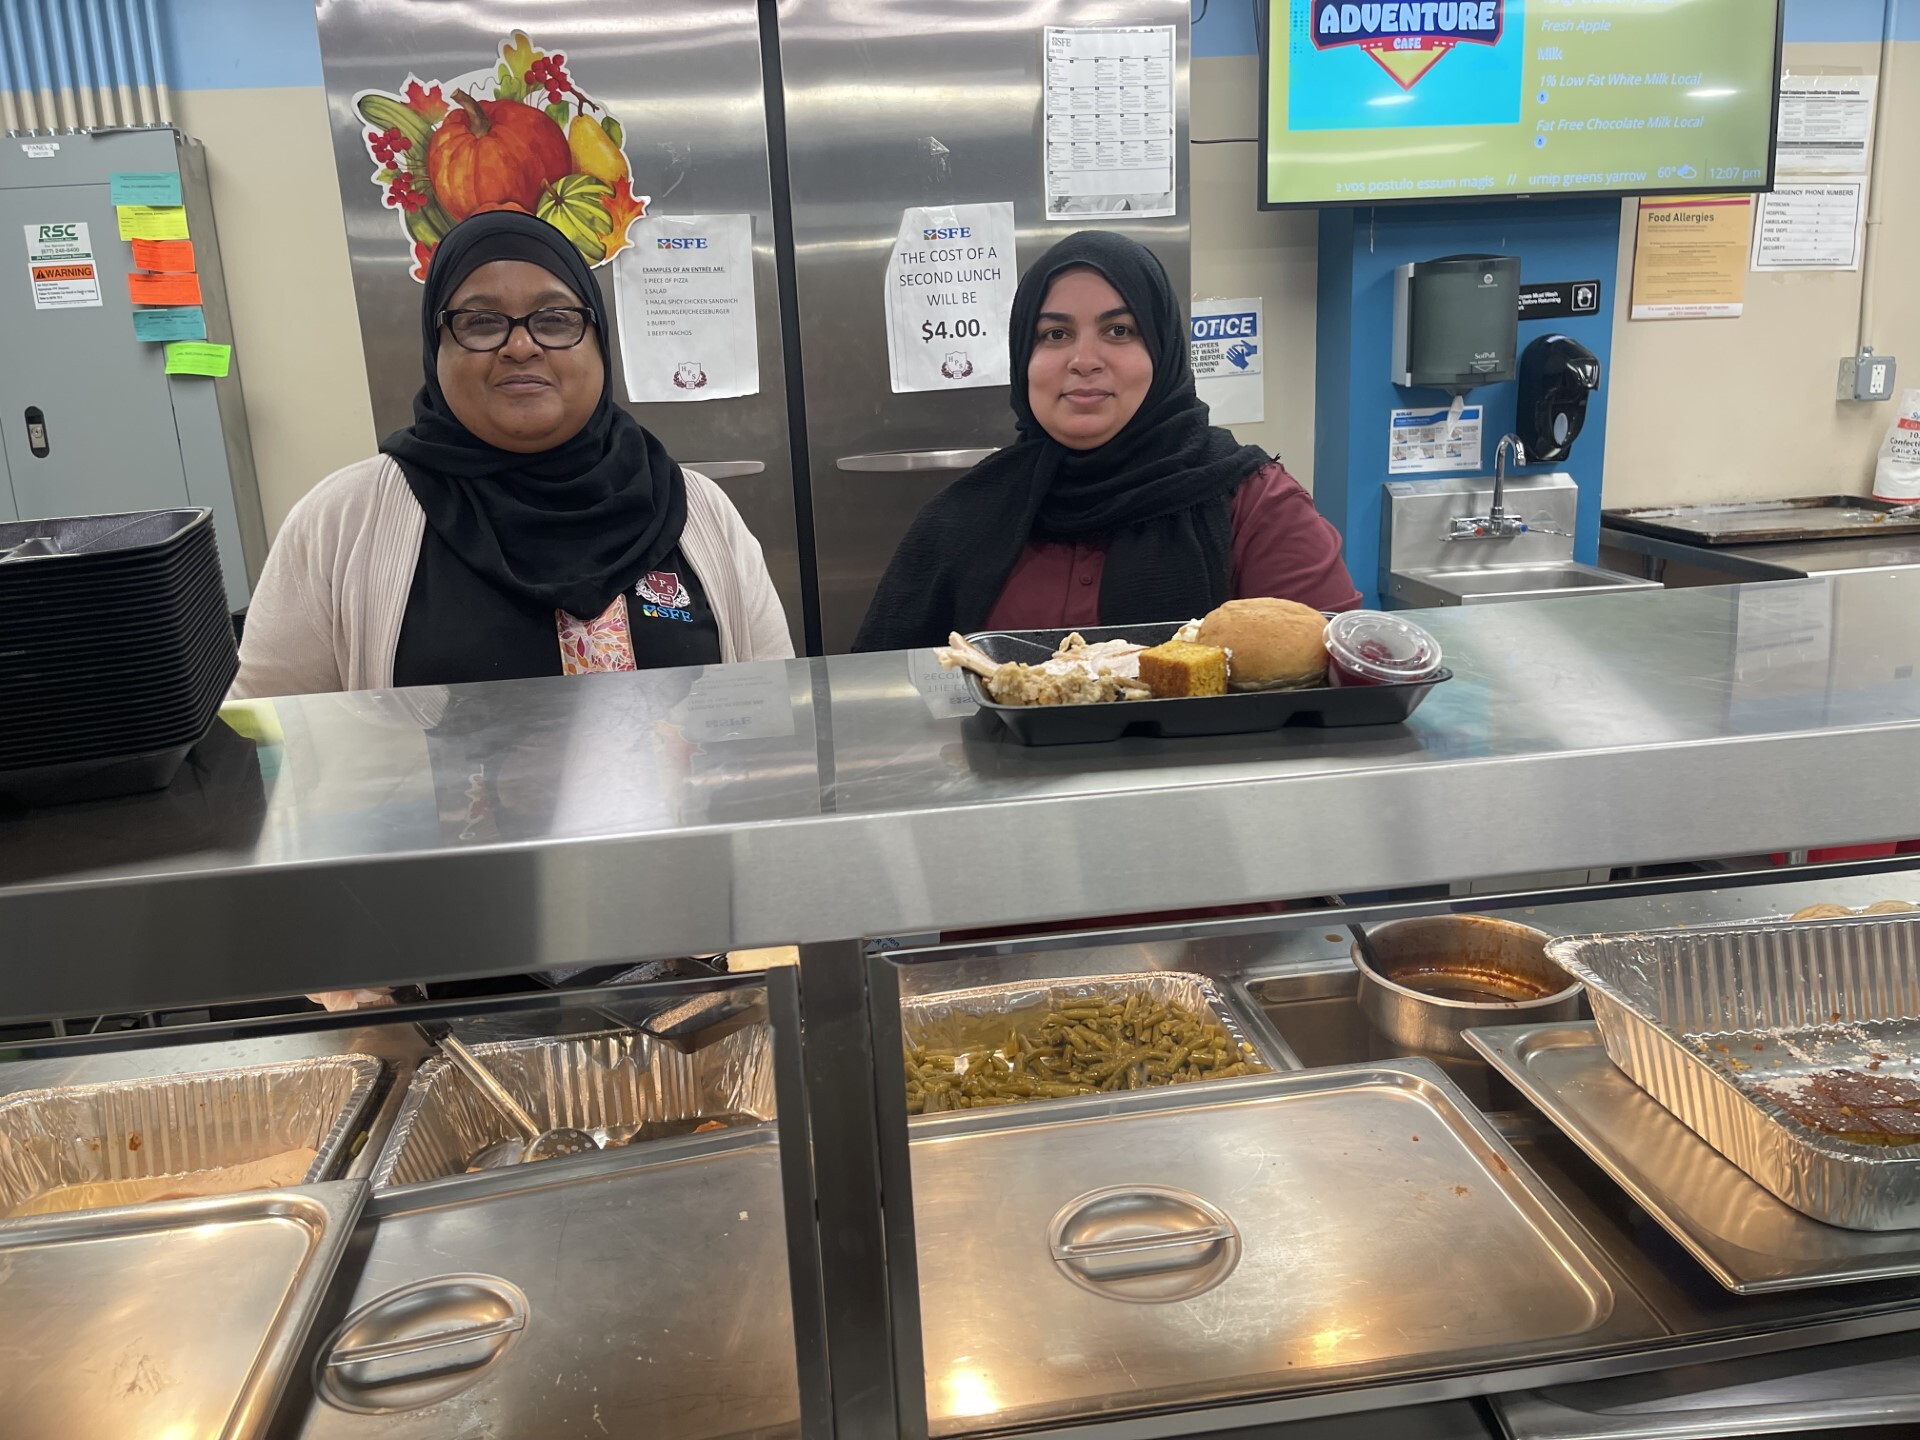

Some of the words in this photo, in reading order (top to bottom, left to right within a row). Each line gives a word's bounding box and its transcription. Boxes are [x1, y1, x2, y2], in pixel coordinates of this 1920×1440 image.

[1319, 2, 1497, 34] ADVENTURE
[1541, 19, 1573, 32] Fresh
[1576, 19, 1611, 34] Apple
[1393, 37, 1421, 50] CAFE
[1537, 47, 1562, 60] Milk
[1540, 75, 1556, 87] 1%
[1559, 74, 1584, 87] Low
[1587, 74, 1605, 86] Fat
[1608, 72, 1641, 86] White
[1645, 72, 1667, 85] Milk
[1671, 72, 1702, 86] Local
[1536, 119, 1554, 131] Fat
[1557, 119, 1584, 131] Free
[1586, 117, 1643, 130] Chocolate
[1647, 116, 1670, 129] Milk
[1673, 116, 1704, 128] Local
[1345, 182, 1365, 192] vos
[1367, 178, 1414, 193] postulo
[1416, 179, 1456, 190] essum
[1459, 175, 1495, 190] magis
[1563, 173, 1603, 187] greens
[1605, 171, 1647, 186] yarrow
[1710, 167, 1739, 180] 12:07
[1742, 168, 1761, 182] pm
[1648, 213, 1671, 222] Food
[1673, 212, 1714, 224] Allergies
[39, 224, 76, 238] RSC
[937, 227, 971, 240] SFE
[672, 238, 708, 249] SFE
[901, 252, 926, 265] THE
[930, 249, 963, 262] COST
[967, 247, 984, 260] OF
[988, 247, 997, 258] A
[45, 267, 92, 278] WARNING
[900, 271, 953, 287] SECOND
[957, 268, 1001, 283] LUNCH
[927, 293, 958, 306] WILL
[962, 292, 977, 304] BE
[921, 319, 986, 343] $4.00.
[657, 607, 693, 622] SFE
